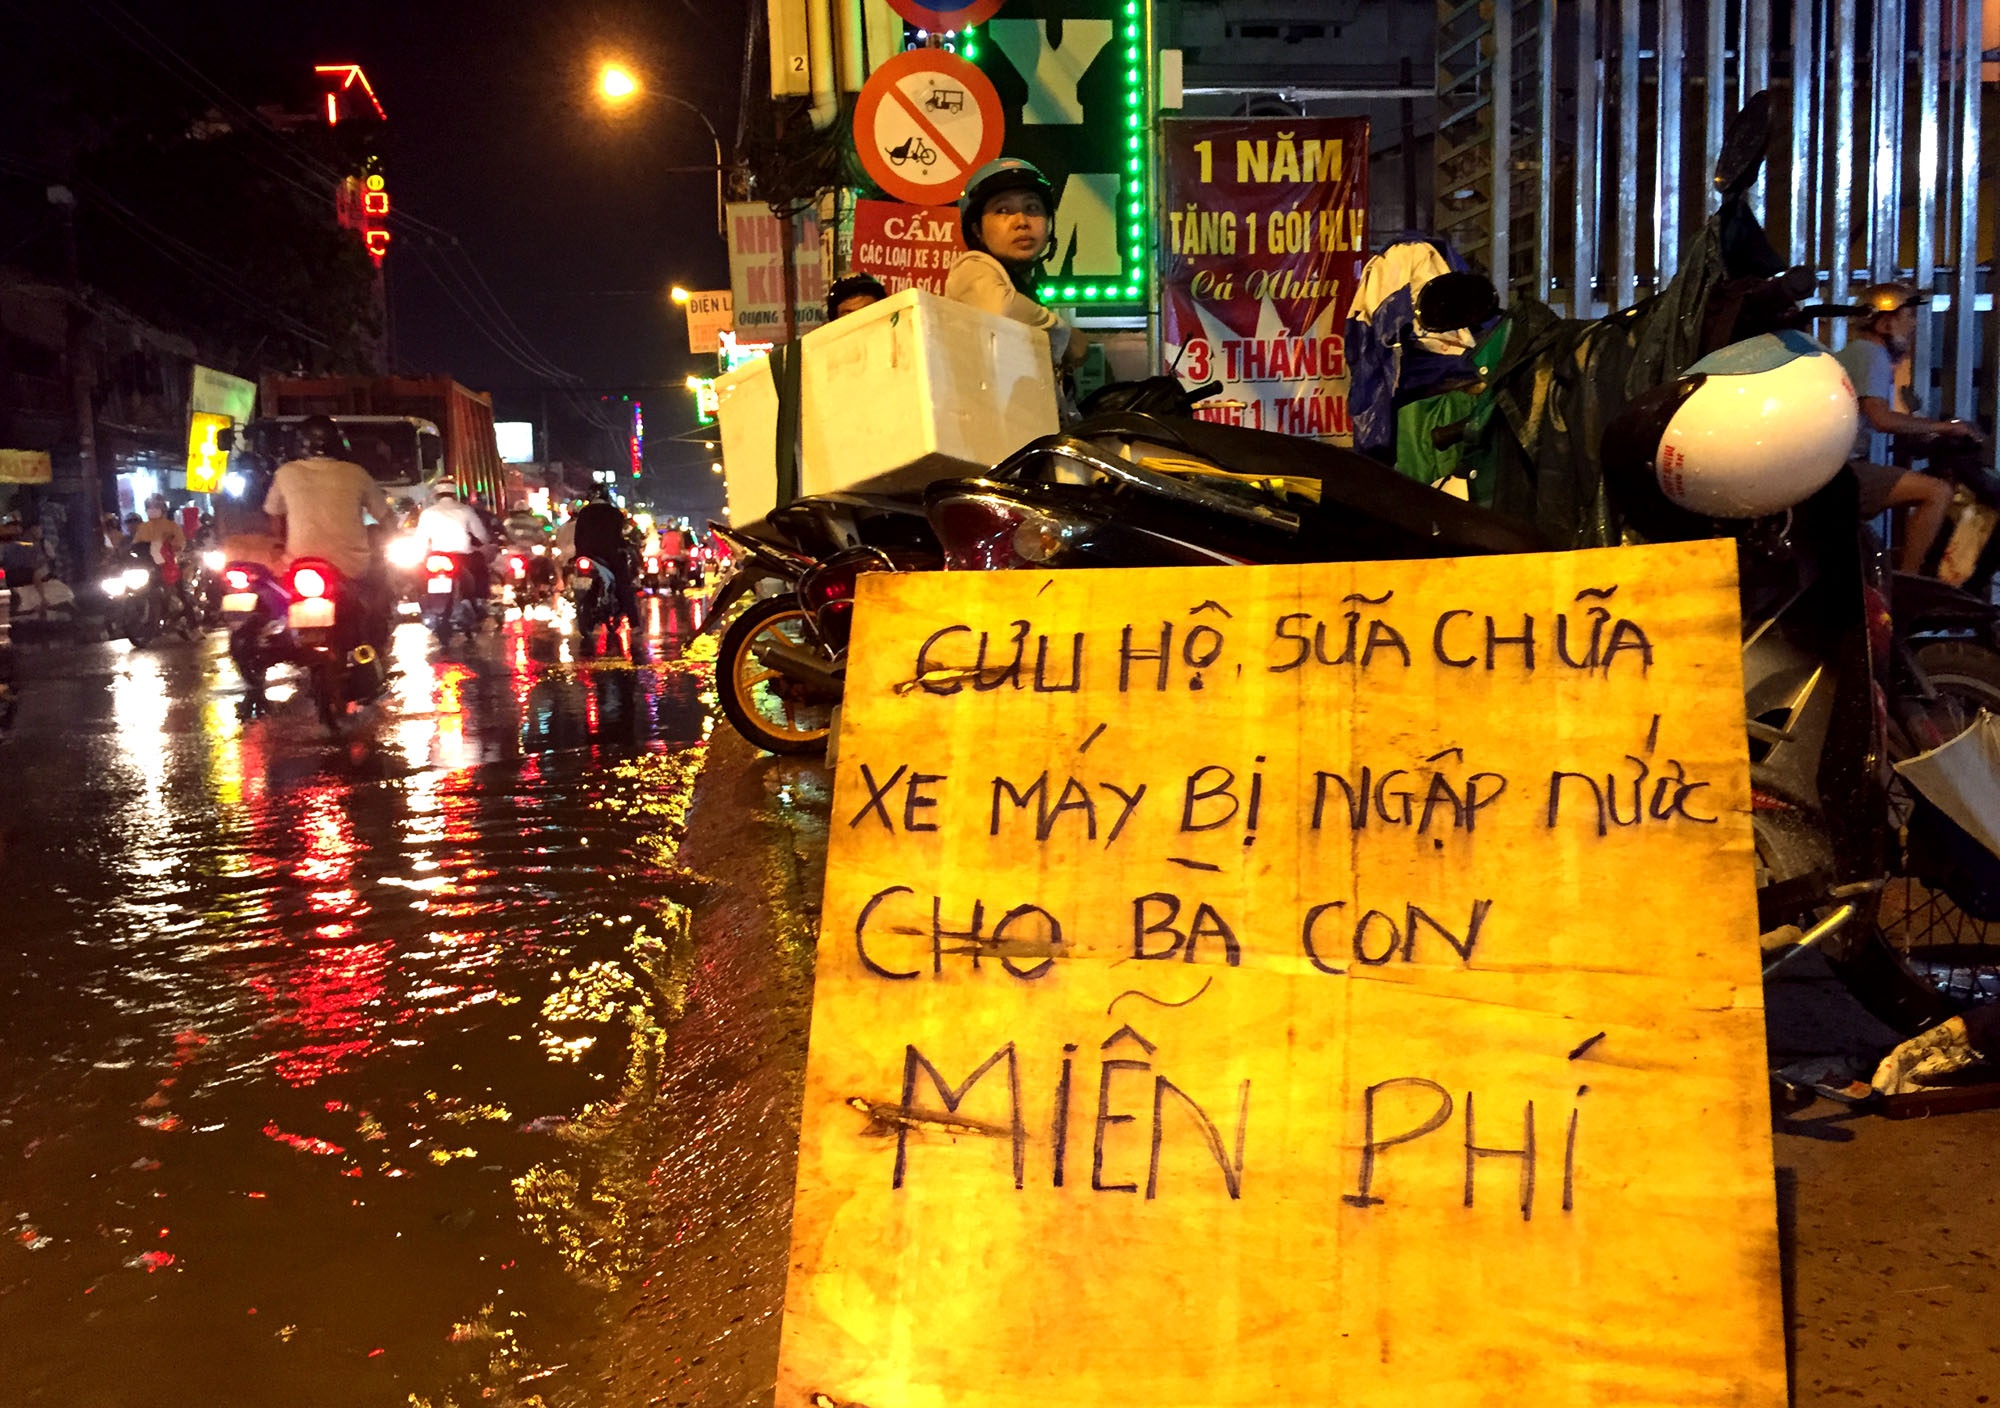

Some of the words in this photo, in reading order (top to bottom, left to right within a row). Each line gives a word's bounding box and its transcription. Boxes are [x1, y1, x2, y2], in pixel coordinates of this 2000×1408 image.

[794, 57, 804, 72] 2
[1193, 139, 1213, 184] 1
[1236, 131, 1344, 184] NĂM
[884, 210, 954, 242] CẤM
[1170, 202, 1237, 265] TẶNG
[1245, 211, 1257, 255] 1
[1268, 201, 1311, 254] GÓI
[1319, 208, 1365, 252] HLV
[860, 239, 883, 264] CÁC
[885, 246, 912, 270] LOẠI
[913, 249, 929, 268] XE
[931, 249, 940, 270] 3
[1190, 269, 1235, 300] Cá
[1245, 269, 1340, 300] Nhân
[1187, 338, 1213, 382] 3
[1221, 328, 1346, 382] THÁNG
[1433, 584, 1653, 675] CHỮA
[849, 764, 948, 835] XE
[990, 723, 1147, 849] MÁY
[1311, 748, 1508, 850] NGẬP
[856, 885, 1063, 980] CHO
[1302, 898, 1493, 975] CON
